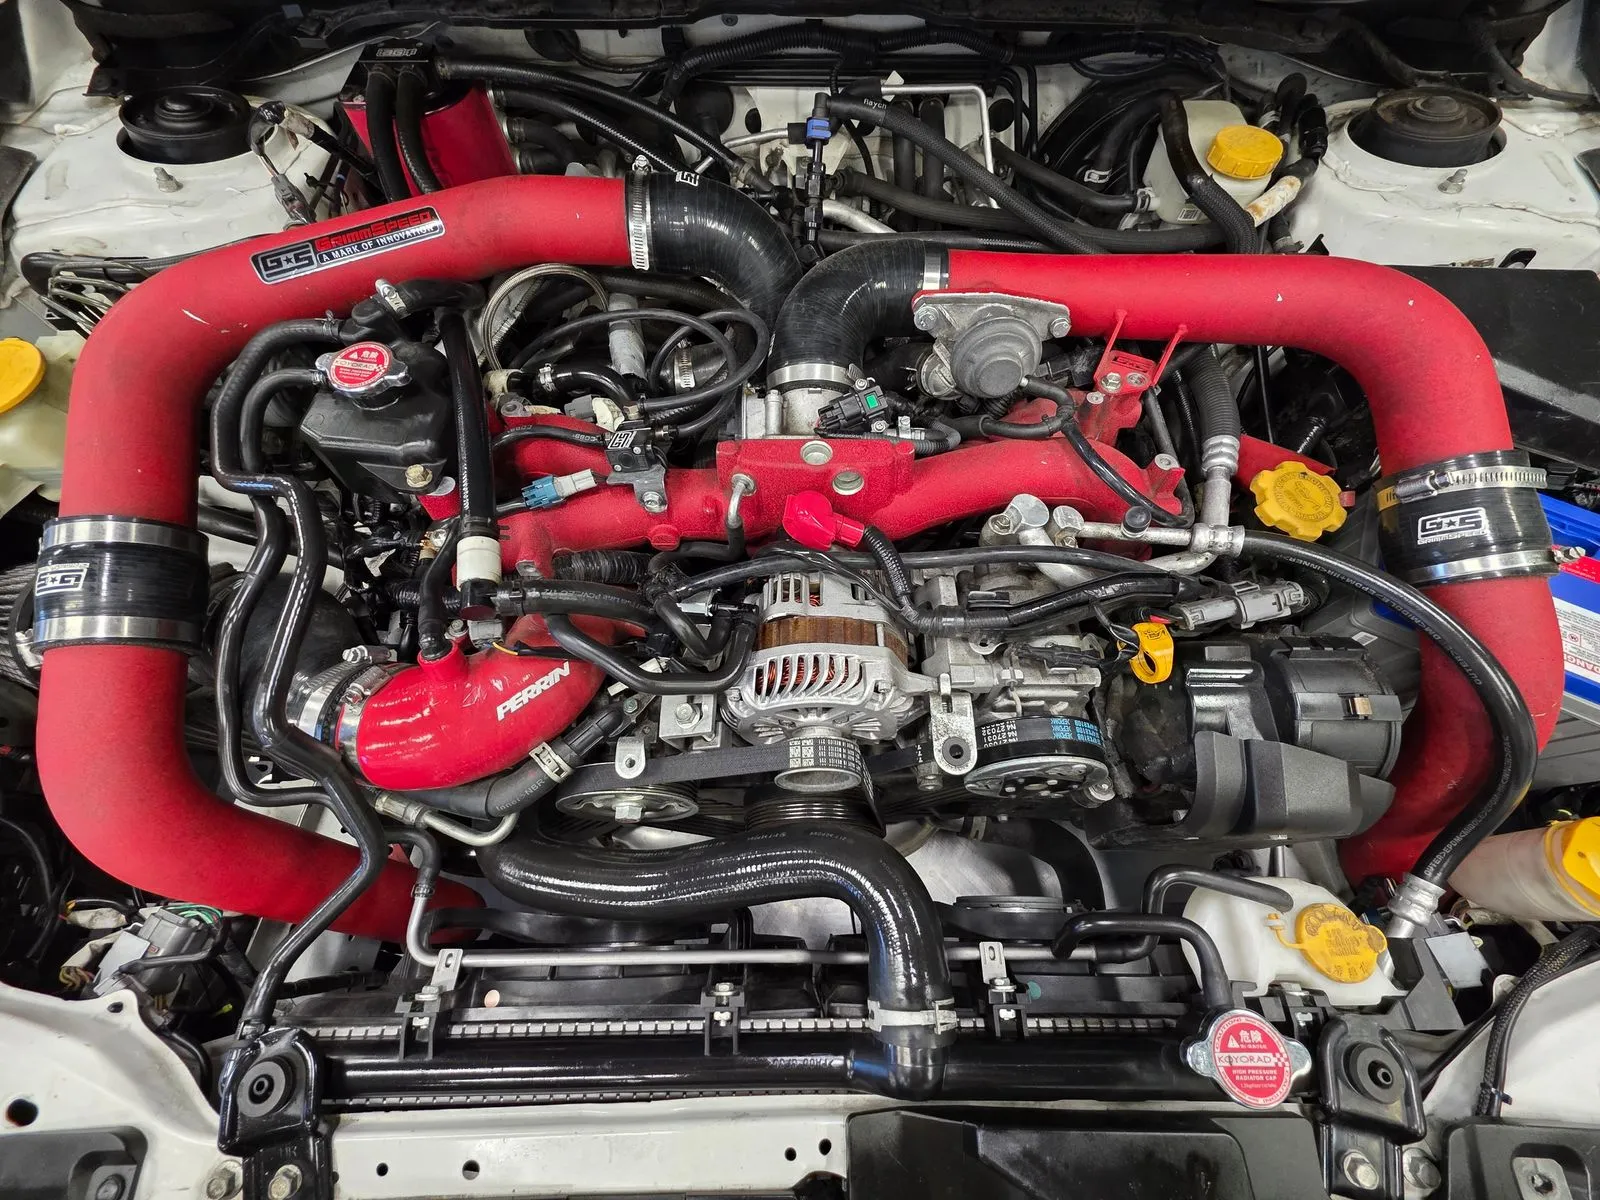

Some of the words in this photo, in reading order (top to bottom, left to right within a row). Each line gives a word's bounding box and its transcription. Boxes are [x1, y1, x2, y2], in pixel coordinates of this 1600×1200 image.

[322, 253, 330, 262] A
[331, 246, 360, 260] MARK
[361, 241, 375, 251] OF
[376, 224, 433, 248] INNOVATION
[496, 660, 571, 722] PERRIN
[1217, 1055, 1272, 1064] KOYORAD
